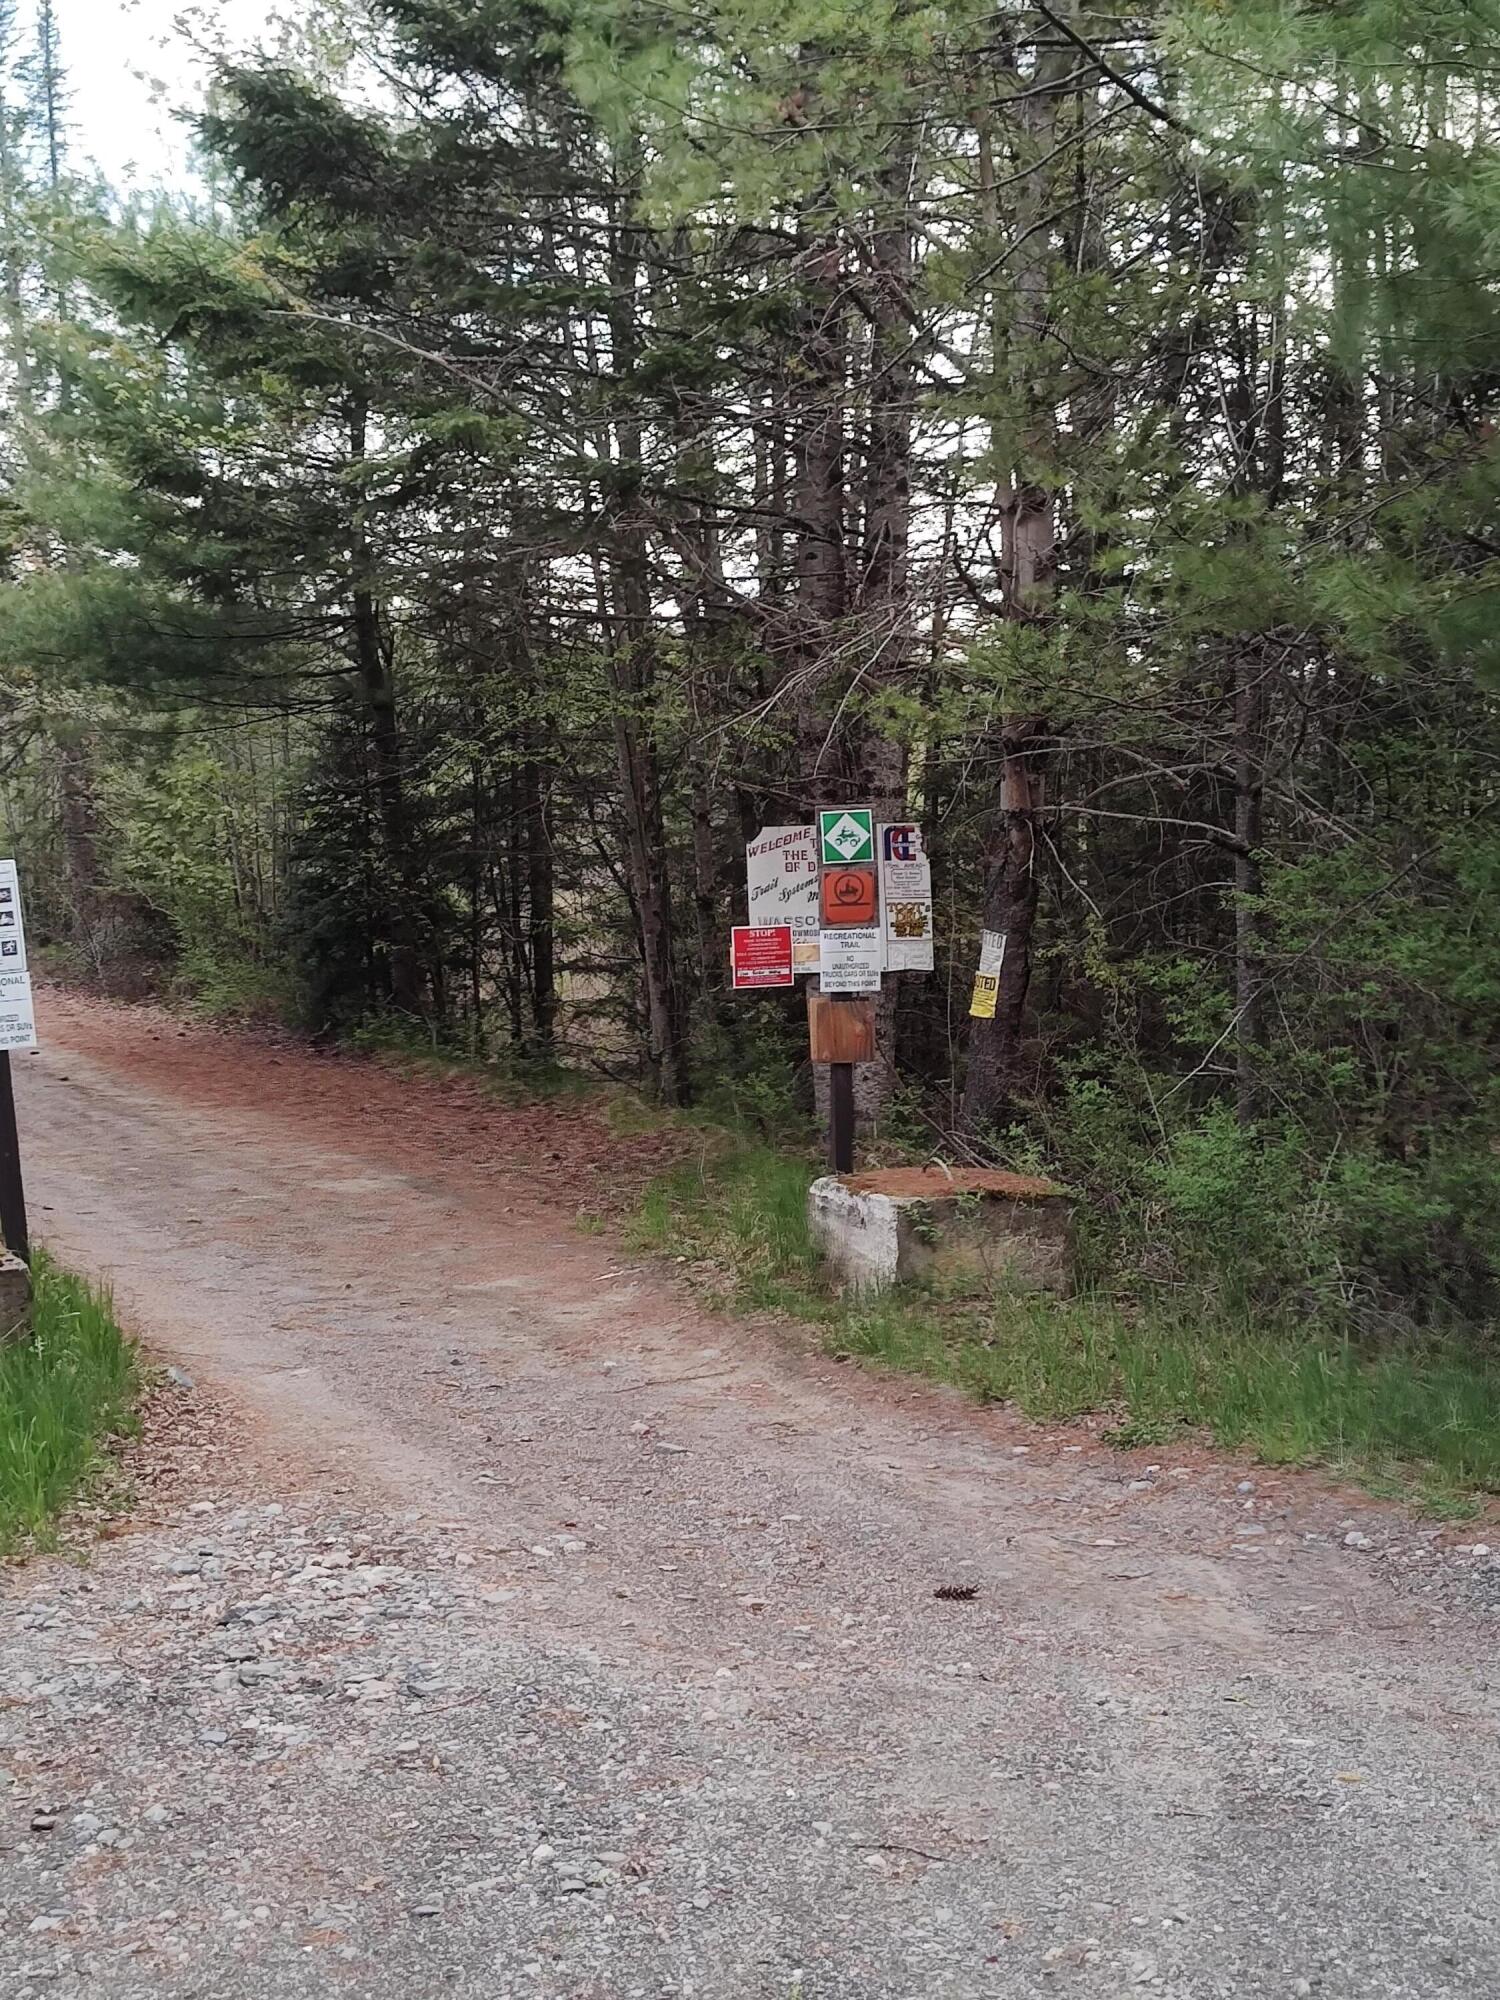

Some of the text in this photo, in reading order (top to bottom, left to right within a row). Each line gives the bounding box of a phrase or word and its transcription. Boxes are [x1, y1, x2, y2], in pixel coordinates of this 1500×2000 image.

[748, 827, 811, 858] WELCOME
[783, 850, 808, 861] THE
[751, 877, 778, 901] Trail
[778, 876, 819, 904] Systems
[758, 915, 820, 928] WASSO
[823, 932, 877, 940] RECREATIONAL
[840, 941, 860, 949] TRAIL
[10, 1034, 31, 1043] POINT
